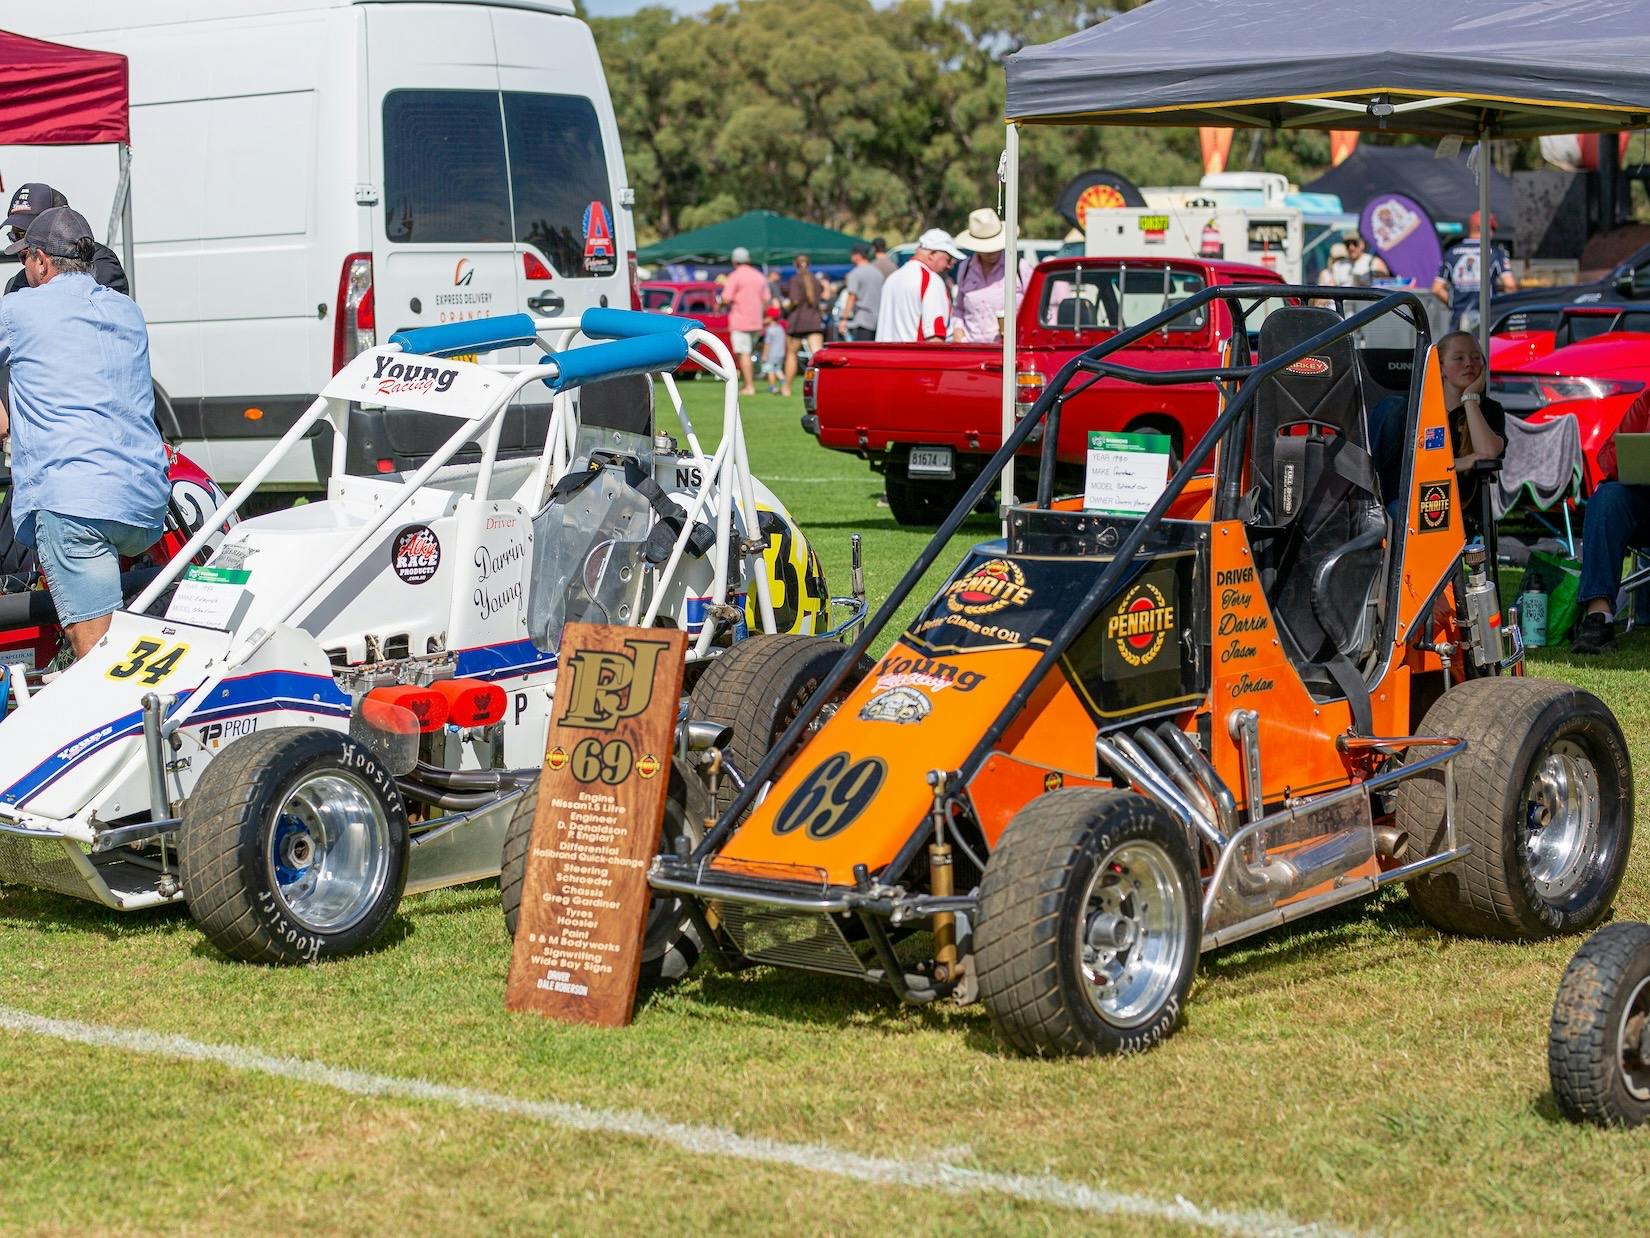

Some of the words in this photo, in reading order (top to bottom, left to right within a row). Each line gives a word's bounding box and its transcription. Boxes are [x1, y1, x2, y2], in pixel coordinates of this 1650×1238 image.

[436, 294, 463, 306] EXPRESS
[464, 293, 492, 305] DELIVERY
[373, 355, 459, 393] Young
[377, 378, 434, 395] Racing
[676, 468, 718, 487] NS
[1420, 500, 1449, 513] PENRITE
[486, 517, 517, 530] Driver
[399, 534, 437, 559] Alky
[396, 555, 438, 568] RACE
[474, 539, 525, 582] Darrin
[400, 567, 434, 576] PRODUCTS
[1216, 567, 1253, 586] DRIVER
[946, 574, 1035, 606] PENRITE
[474, 581, 523, 620] Young
[946, 614, 981, 633] Class
[981, 625, 998, 637] of
[1107, 607, 1174, 640] PENRITE
[1218, 612, 1268, 636] Darrin
[1221, 640, 1256, 663] Jason
[109, 639, 188, 685] 34
[876, 656, 987, 692] Young
[1232, 674, 1274, 698] Jordan
[515, 693, 528, 726] P
[224, 718, 257, 737] PRO1
[571, 737, 633, 785] 69
[337, 742, 402, 812] Hoosier
[579, 792, 615, 805] Engine
[772, 752, 888, 841] 69
[603, 803, 626, 814] Litre
[570, 812, 617, 825] Engineer
[558, 821, 567, 830] D.
[570, 822, 627, 836] Donaldson
[560, 842, 619, 856] Differential
[563, 863, 609, 877] Steering
[579, 853, 644, 869] Quick-change
[556, 872, 613, 887] Schroeder
[562, 885, 604, 898] Chassis
[543, 893, 570, 906] Greg
[572, 896, 621, 910] Gardiner
[566, 907, 593, 919] Tyres
[557, 916, 599, 929] Hoosier
[529, 933, 536, 942] B
[538, 935, 546, 944] &
[548, 936, 558, 945] M
[560, 937, 620, 953] Bodyworks
[562, 928, 590, 940] Paint
[531, 955, 558, 967] Wide
[560, 959, 581, 971] Bay
[584, 961, 613, 974] Signs
[543, 947, 602, 964] Signwriting
[537, 979, 555, 991] DALE
